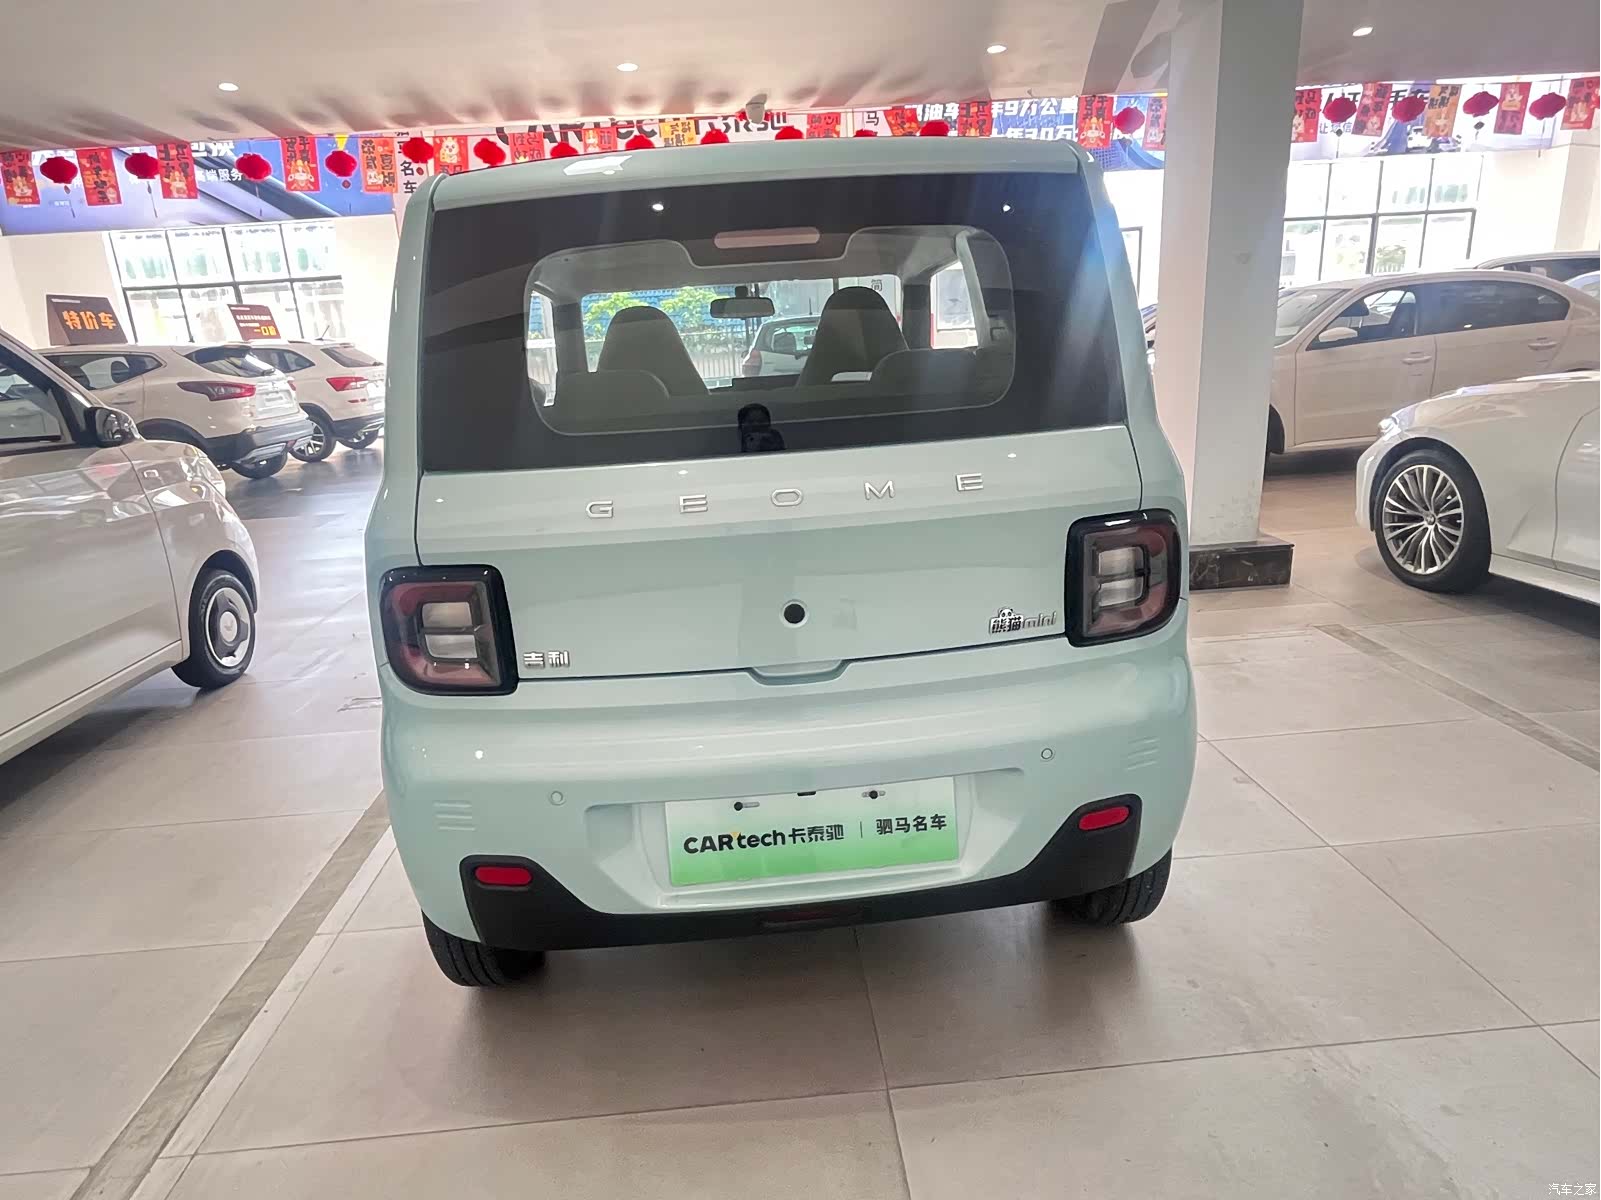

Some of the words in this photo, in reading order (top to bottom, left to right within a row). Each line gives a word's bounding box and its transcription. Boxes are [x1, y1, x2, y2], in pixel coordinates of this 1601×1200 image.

[62, 310, 117, 330] 特价车
[523, 650, 570, 668] 吉利
[876, 813, 948, 836] 驷马名车
